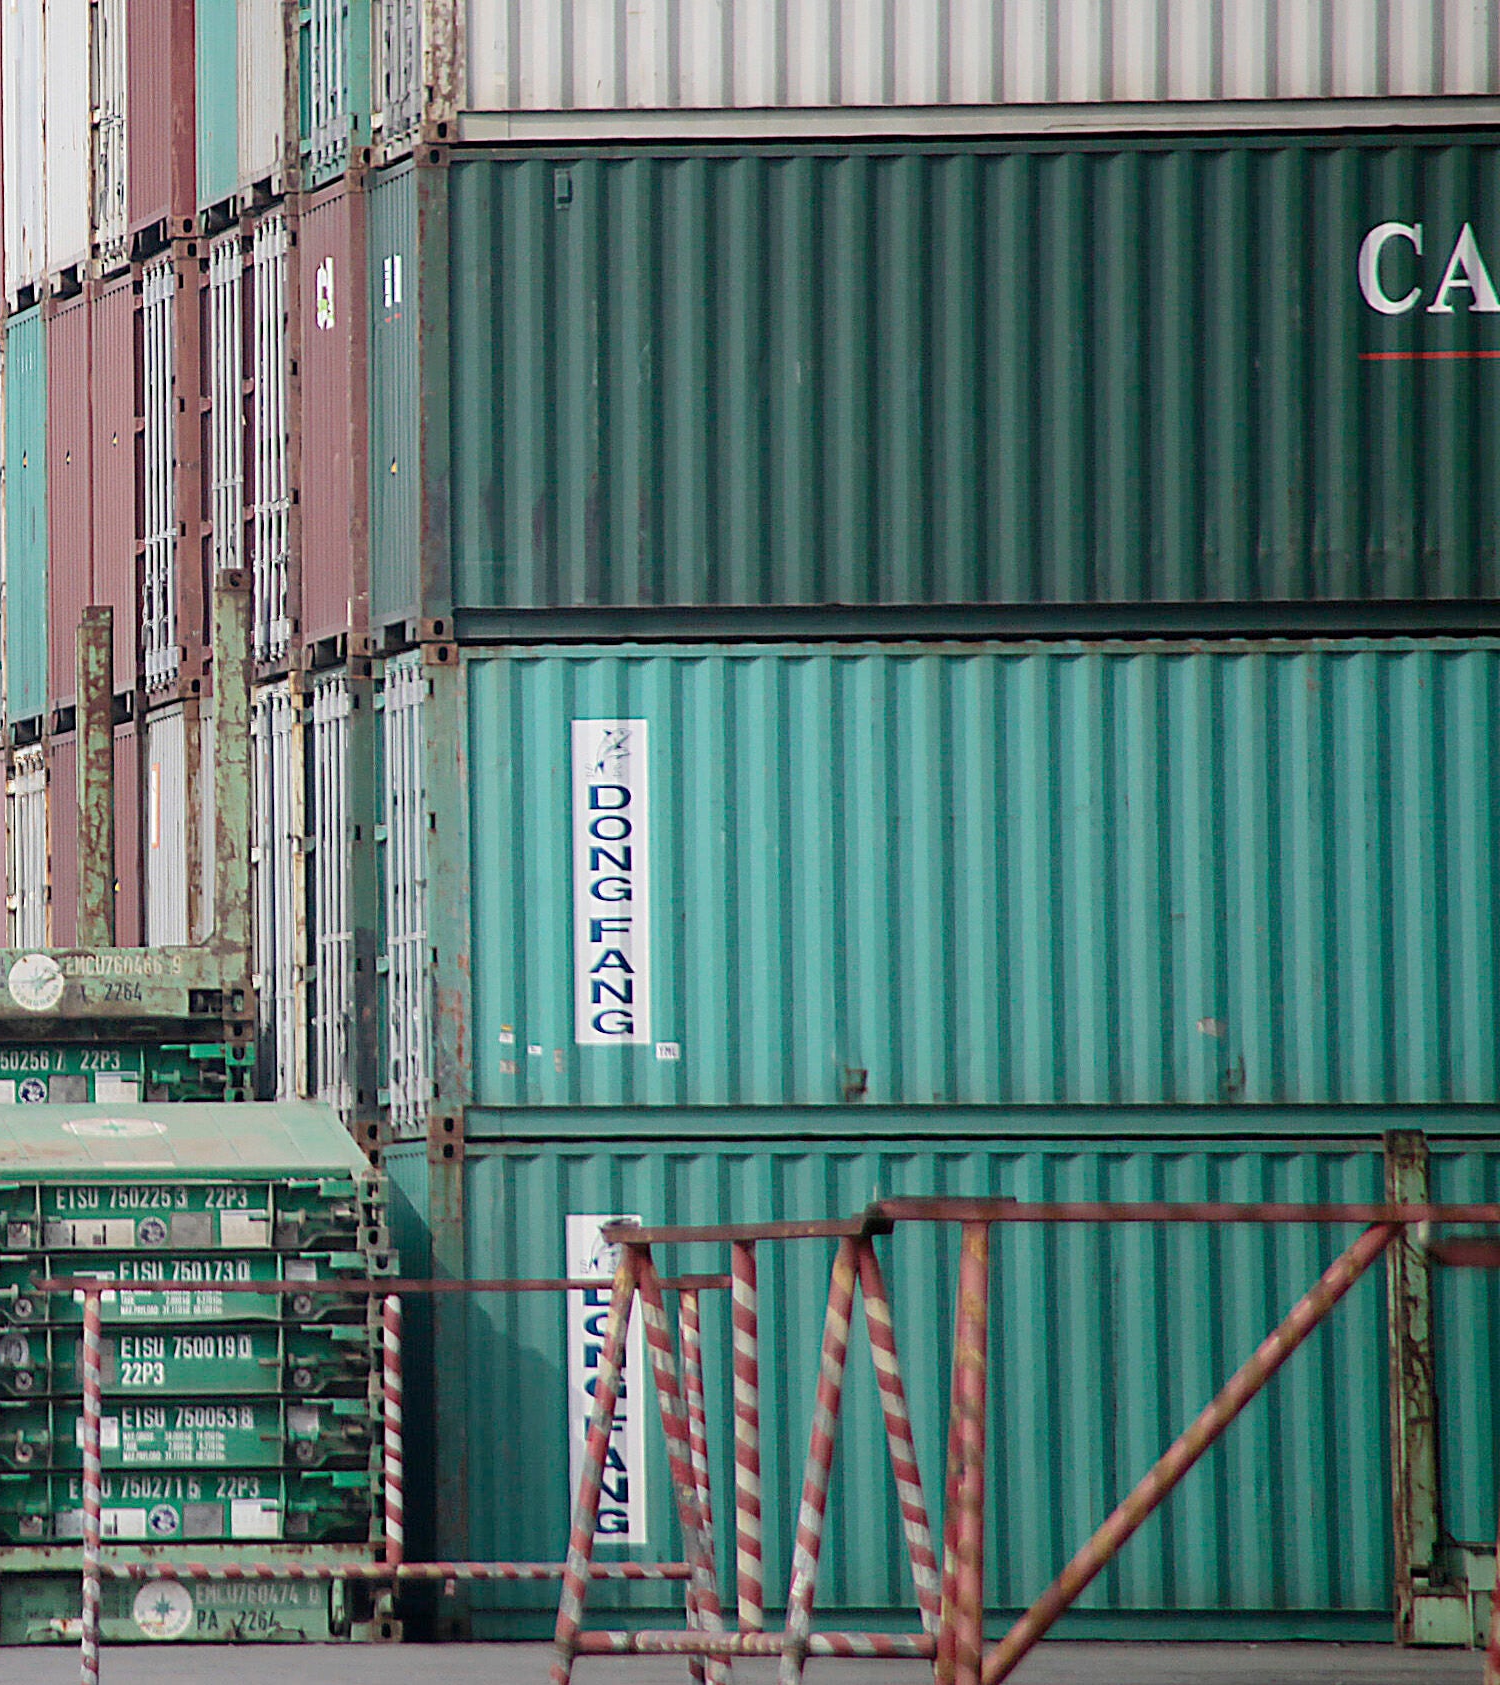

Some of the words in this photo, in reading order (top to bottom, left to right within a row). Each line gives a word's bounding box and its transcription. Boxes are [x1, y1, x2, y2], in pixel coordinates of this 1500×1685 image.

[588, 784, 633, 902] DONG
[589, 917, 635, 1035] FANG
[80, 1050, 121, 1070] 22P3
[56, 1187, 98, 1209] EISU
[205, 1187, 248, 1208] 22P3
[121, 1336, 164, 1358] EISU
[121, 1362, 164, 1386] 22P3
[122, 1407, 165, 1428] EISU
[69, 1477, 111, 1498] EU
[216, 1476, 259, 1498] 22P3
[197, 1609, 219, 1630] PA
